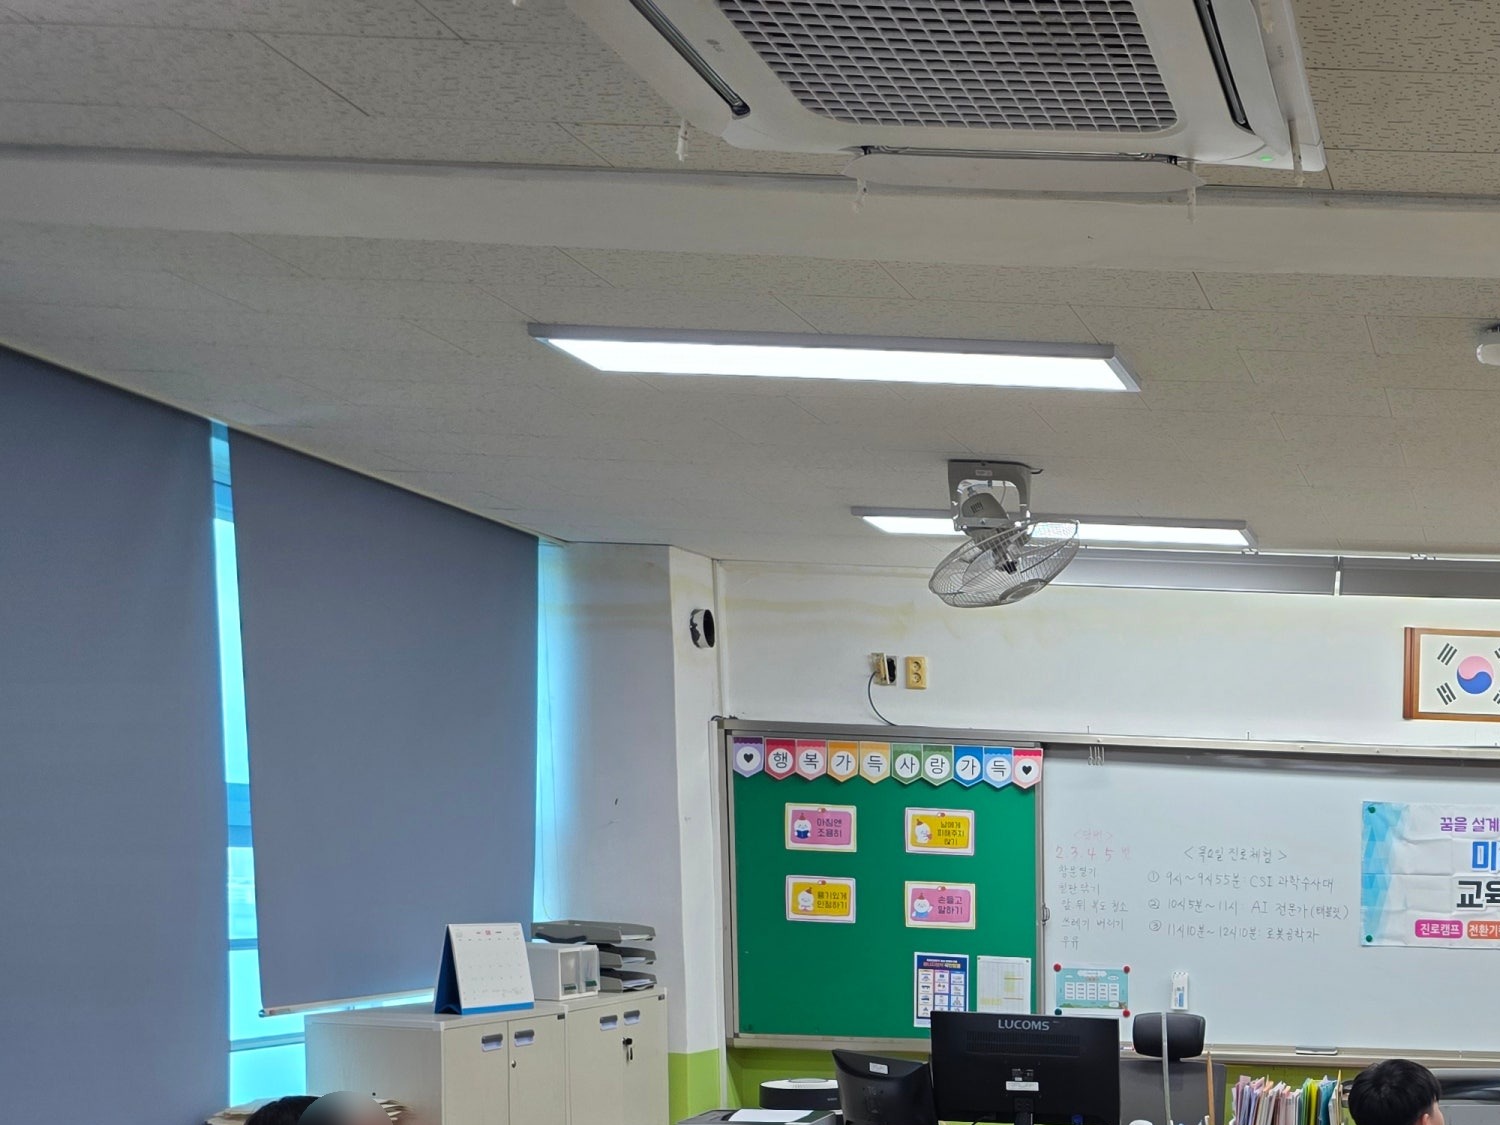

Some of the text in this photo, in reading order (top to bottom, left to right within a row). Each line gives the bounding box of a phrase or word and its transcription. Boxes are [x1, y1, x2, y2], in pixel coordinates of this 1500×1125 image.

[816, 818, 843, 827] 아침엔
[1439, 817, 1467, 832] 꿈을
[817, 829, 843, 838] 조용히
[1249, 874, 1274, 888] CSI
[1278, 874, 1334, 894] 과학수사대
[817, 890, 848, 901] 용기있게
[937, 895, 963, 905] 손들고
[937, 905, 964, 915] 말하기
[1250, 900, 1269, 914] AI
[1419, 921, 1461, 936] 진로캠프
[998, 1018, 1050, 1031] LUCOMS
